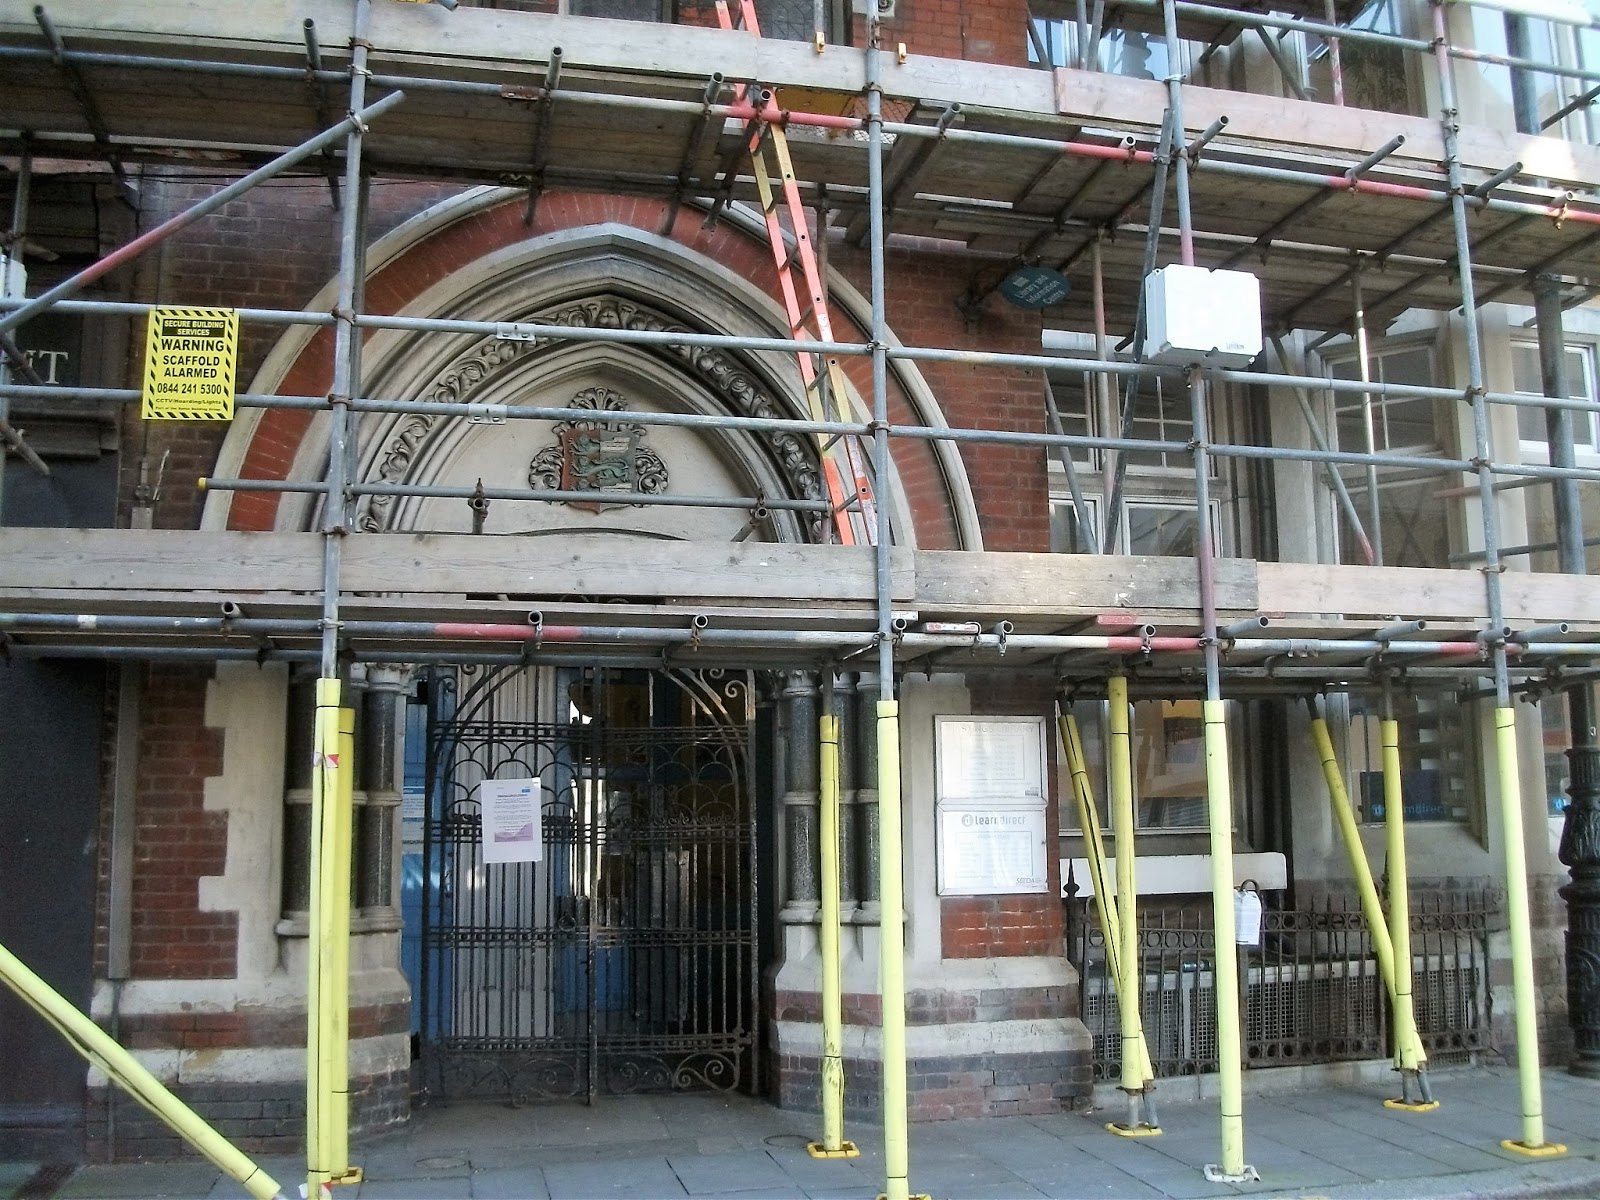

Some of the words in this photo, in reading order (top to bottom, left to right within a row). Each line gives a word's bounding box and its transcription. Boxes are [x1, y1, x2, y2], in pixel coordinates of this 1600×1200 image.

[164, 320, 191, 328] SECURE
[192, 321, 224, 329] BUILDING
[177, 328, 210, 336] SERVICES
[161, 338, 225, 352] WARNING
[163, 355, 220, 366] SCAFFOLD
[164, 367, 217, 379] ALARMED
[157, 383, 179, 394] 0844
[181, 384, 197, 394] 241
[200, 384, 222, 395] 5300
